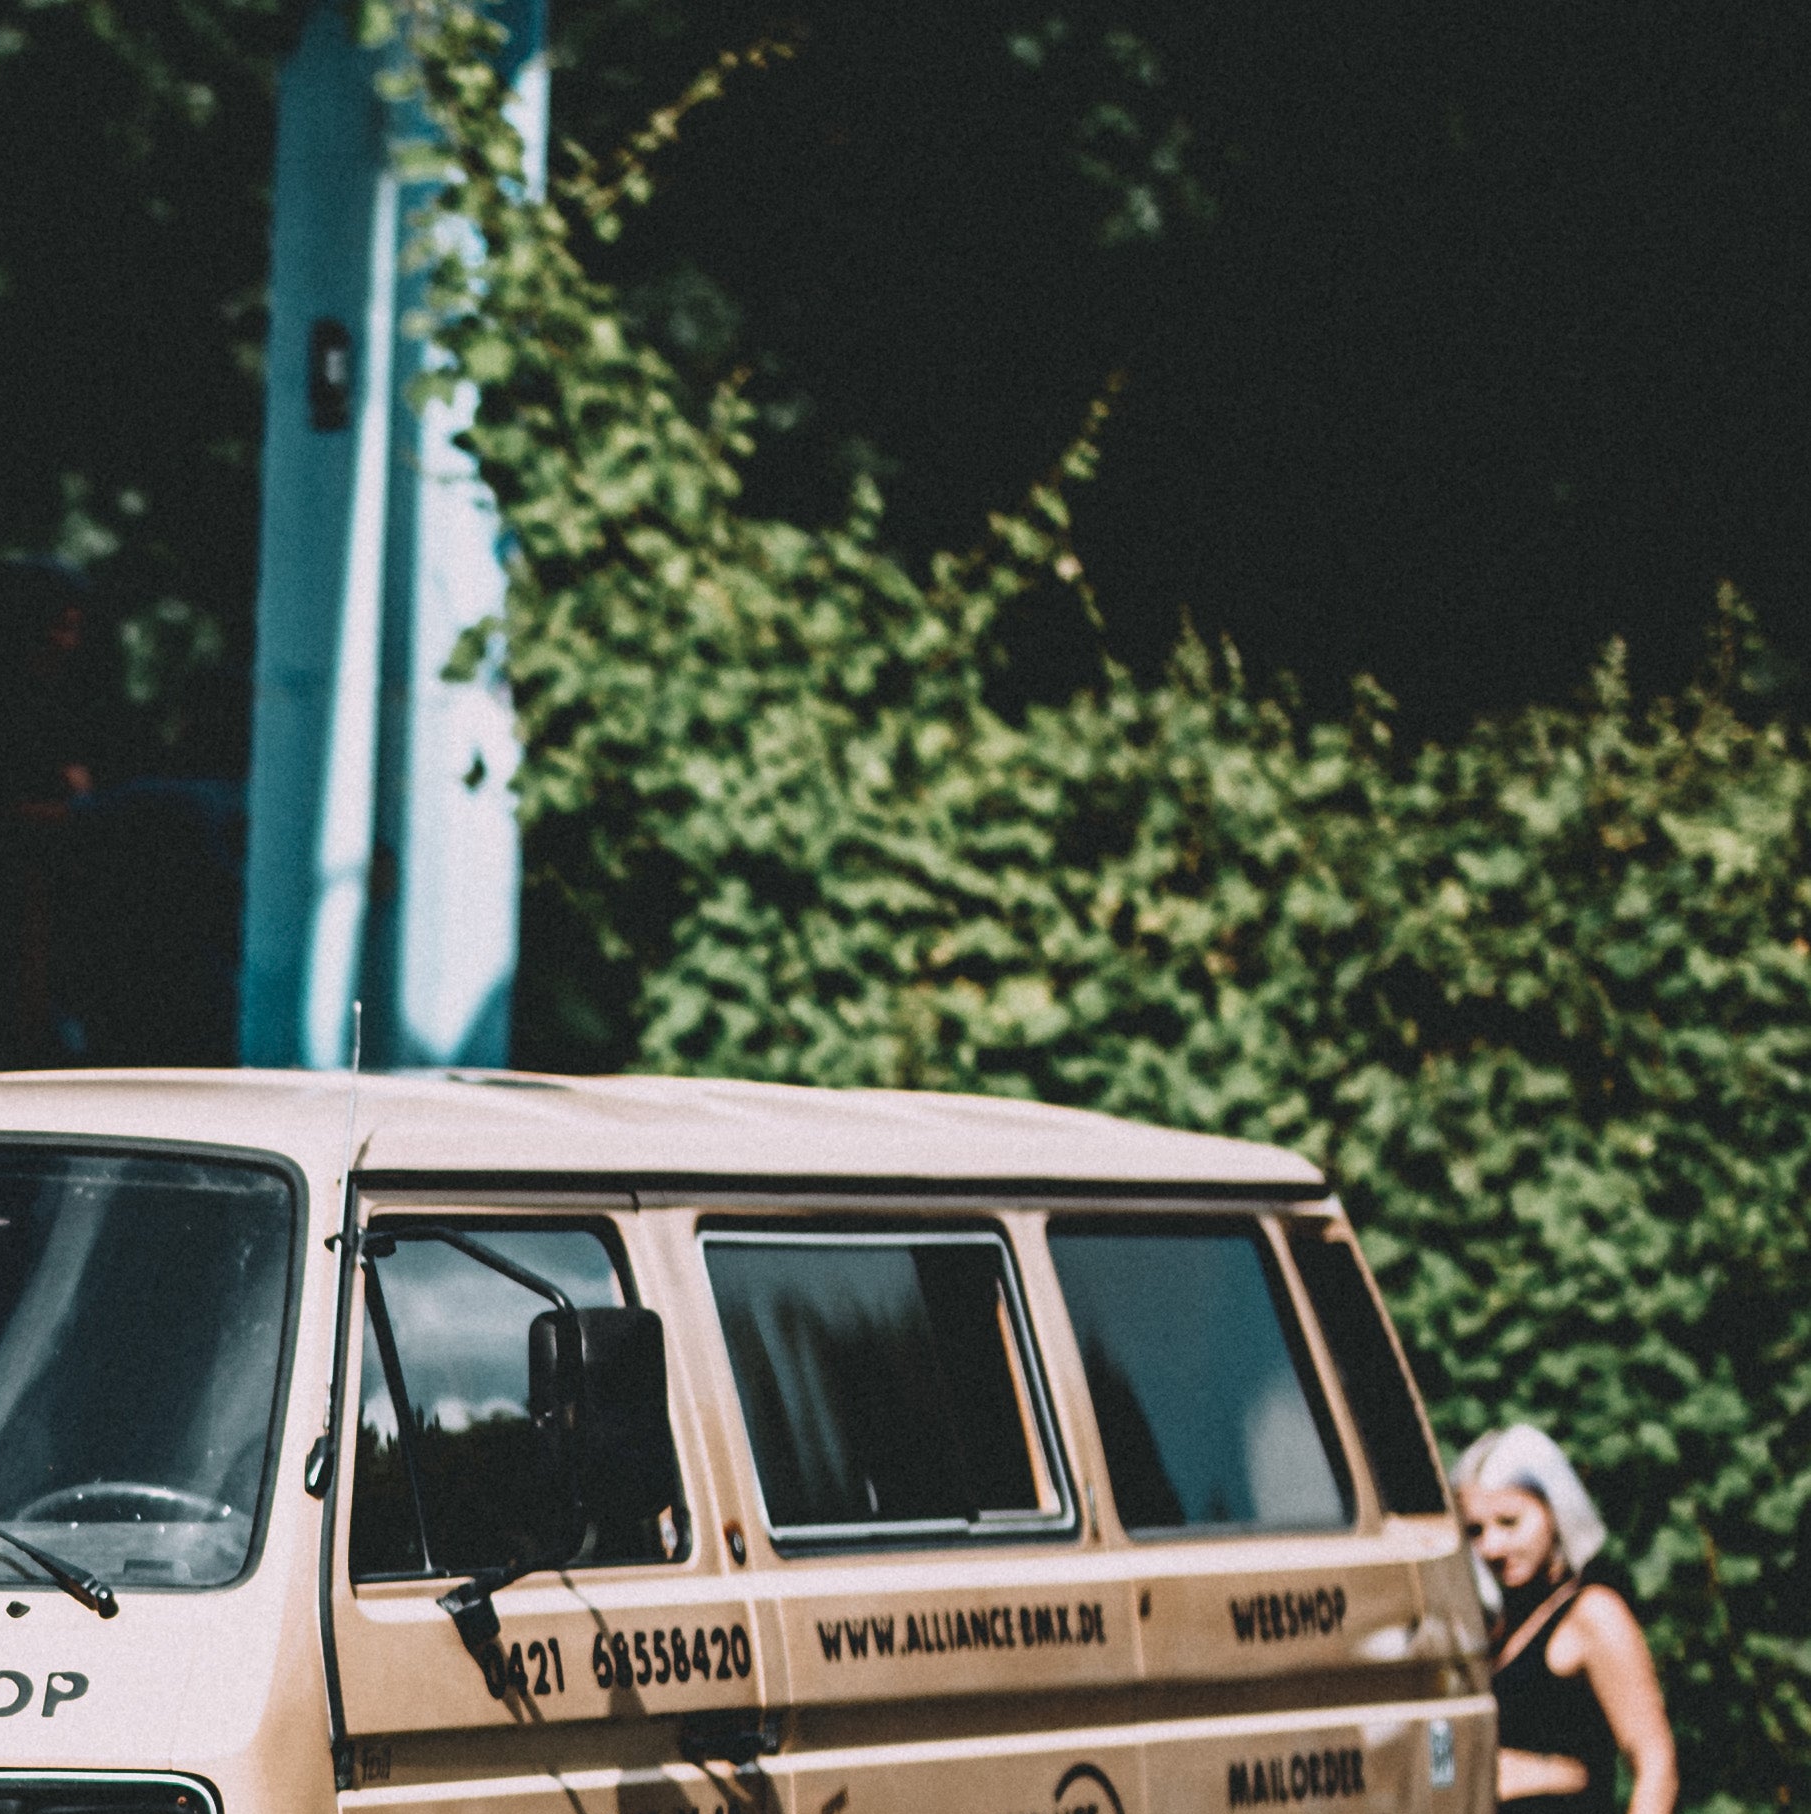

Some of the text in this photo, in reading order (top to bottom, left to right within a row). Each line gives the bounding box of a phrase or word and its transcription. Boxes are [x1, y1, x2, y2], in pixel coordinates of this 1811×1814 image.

[1230, 1585, 1347, 1644] WEBSHOP
[592, 1623, 752, 1689] 68558420
[1228, 1746, 1366, 1809] MAILORDER
